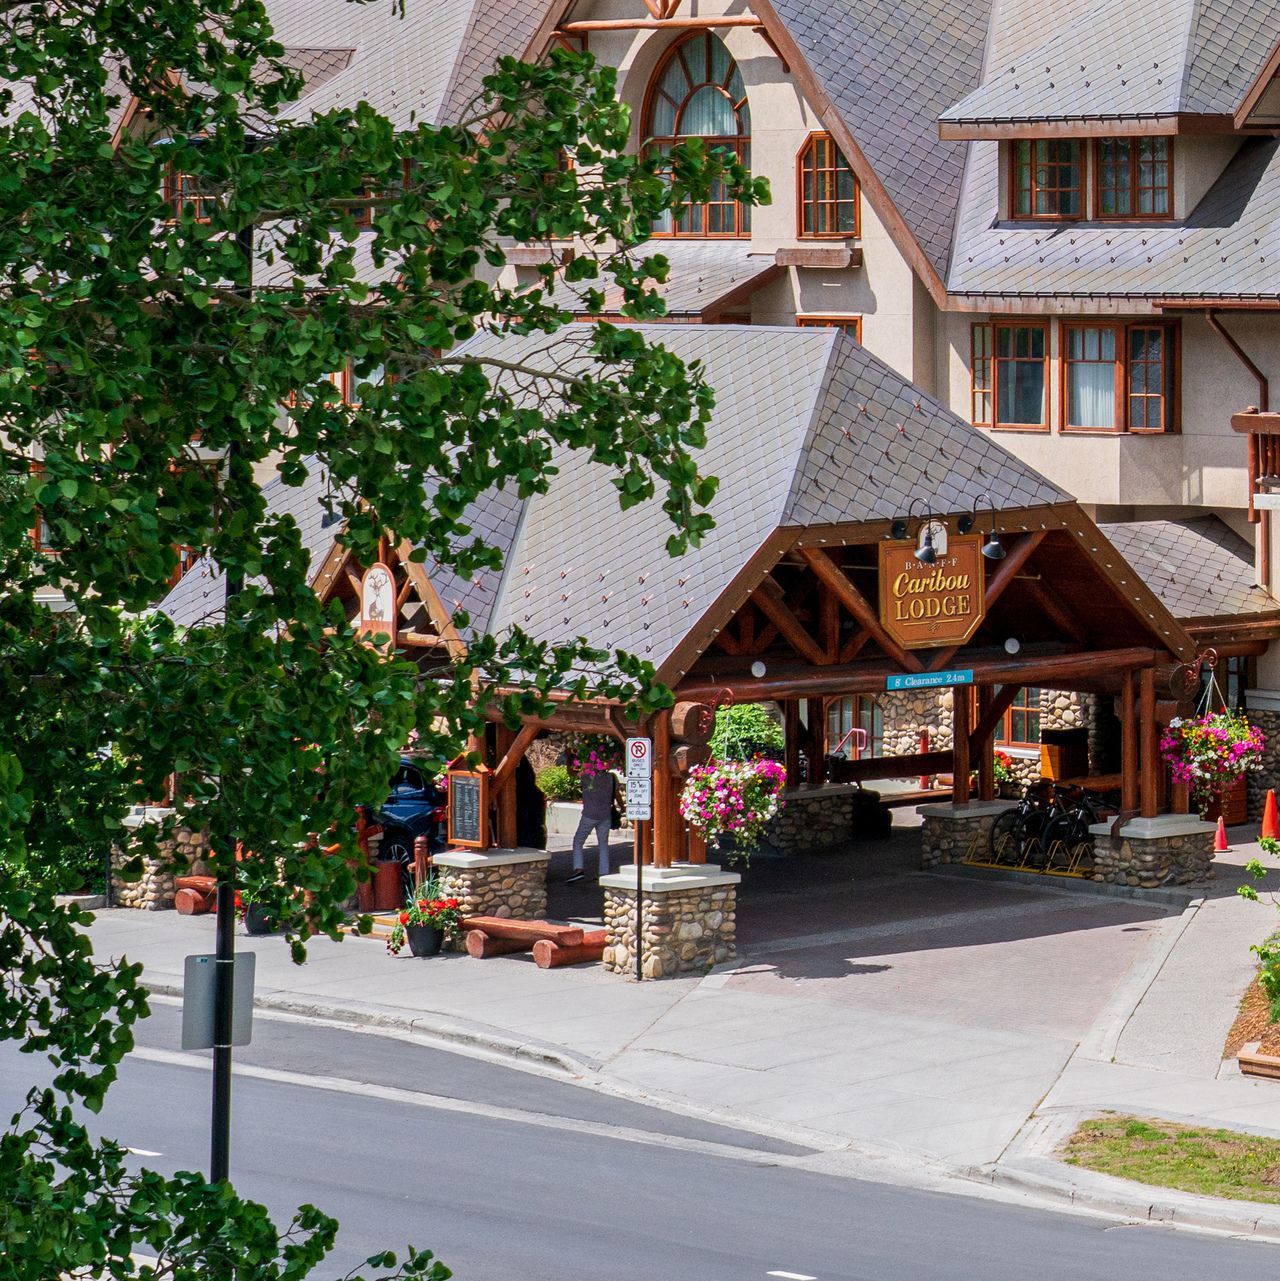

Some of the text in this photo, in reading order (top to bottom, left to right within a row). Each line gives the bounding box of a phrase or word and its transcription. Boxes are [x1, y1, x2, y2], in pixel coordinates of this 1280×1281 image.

[893, 569, 971, 598] Caribou
[895, 595, 971, 620] LODGE
[905, 676, 943, 686] Clearance
